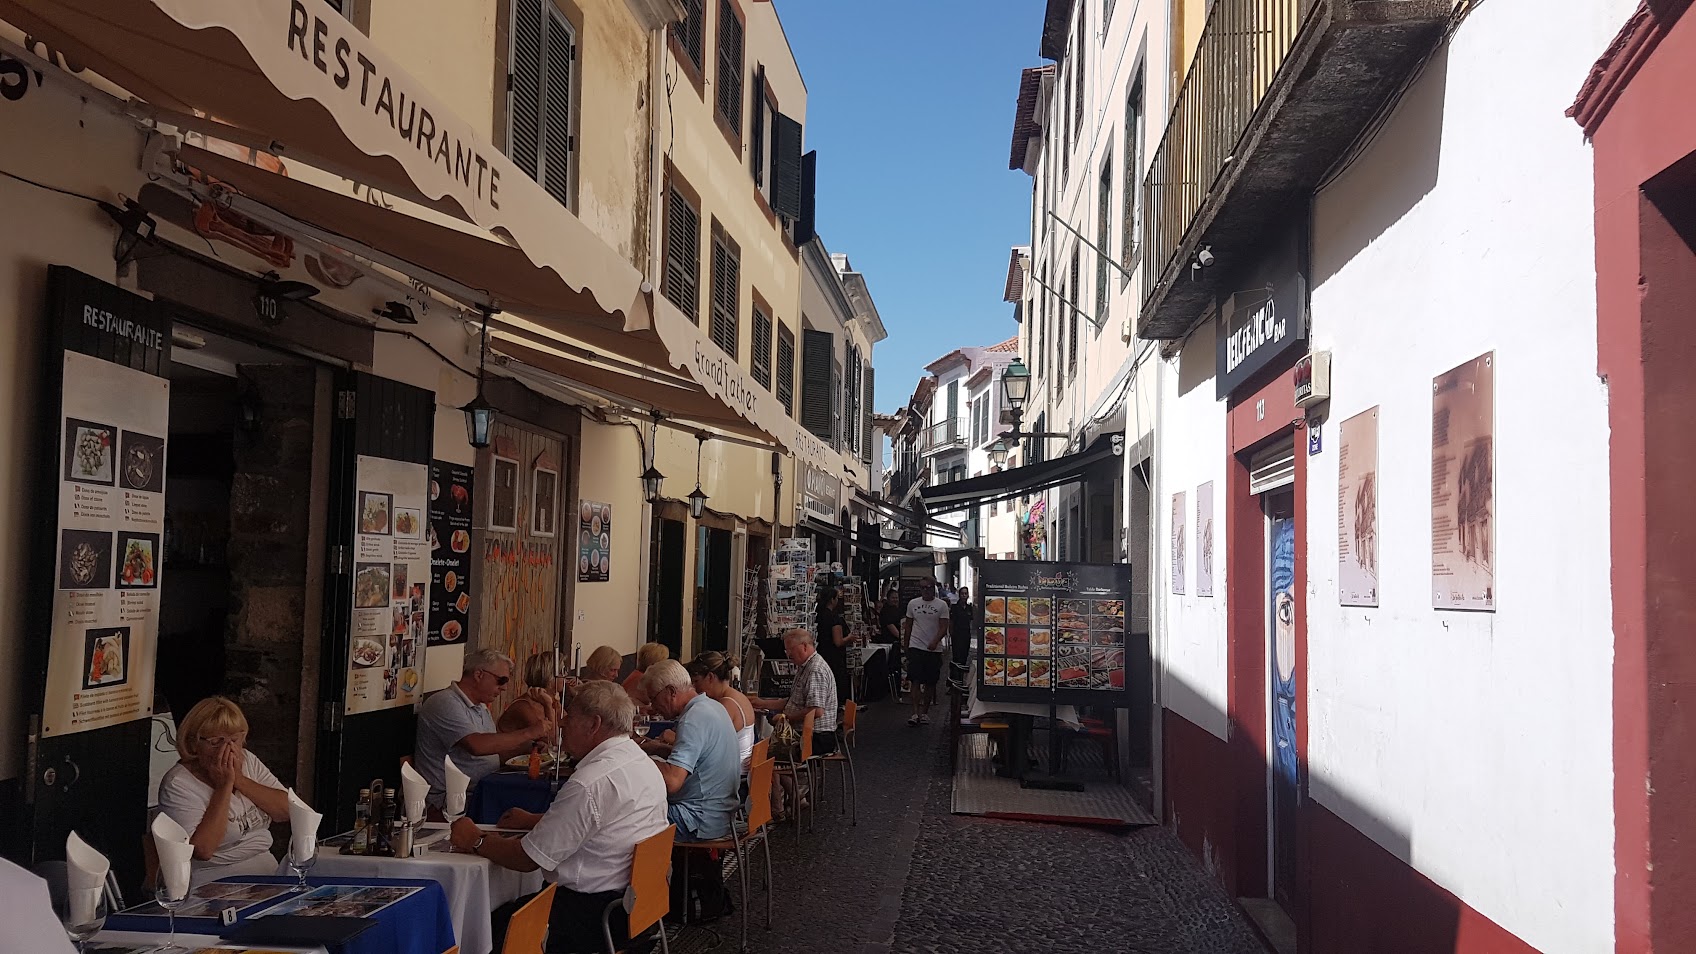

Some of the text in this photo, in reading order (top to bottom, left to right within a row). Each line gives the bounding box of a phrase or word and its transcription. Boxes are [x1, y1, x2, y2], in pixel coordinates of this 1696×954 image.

[287, 0, 501, 210] RESTAURANTE
[259, 296, 277, 320] 110
[83, 304, 163, 351] RESTAURANTE
[1274, 318, 1287, 344] BAR
[694, 340, 759, 414] Grandfather
[1256, 398, 1266, 422] 113
[795, 429, 828, 466] RESTAURANTE
[227, 910, 234, 923] 8
